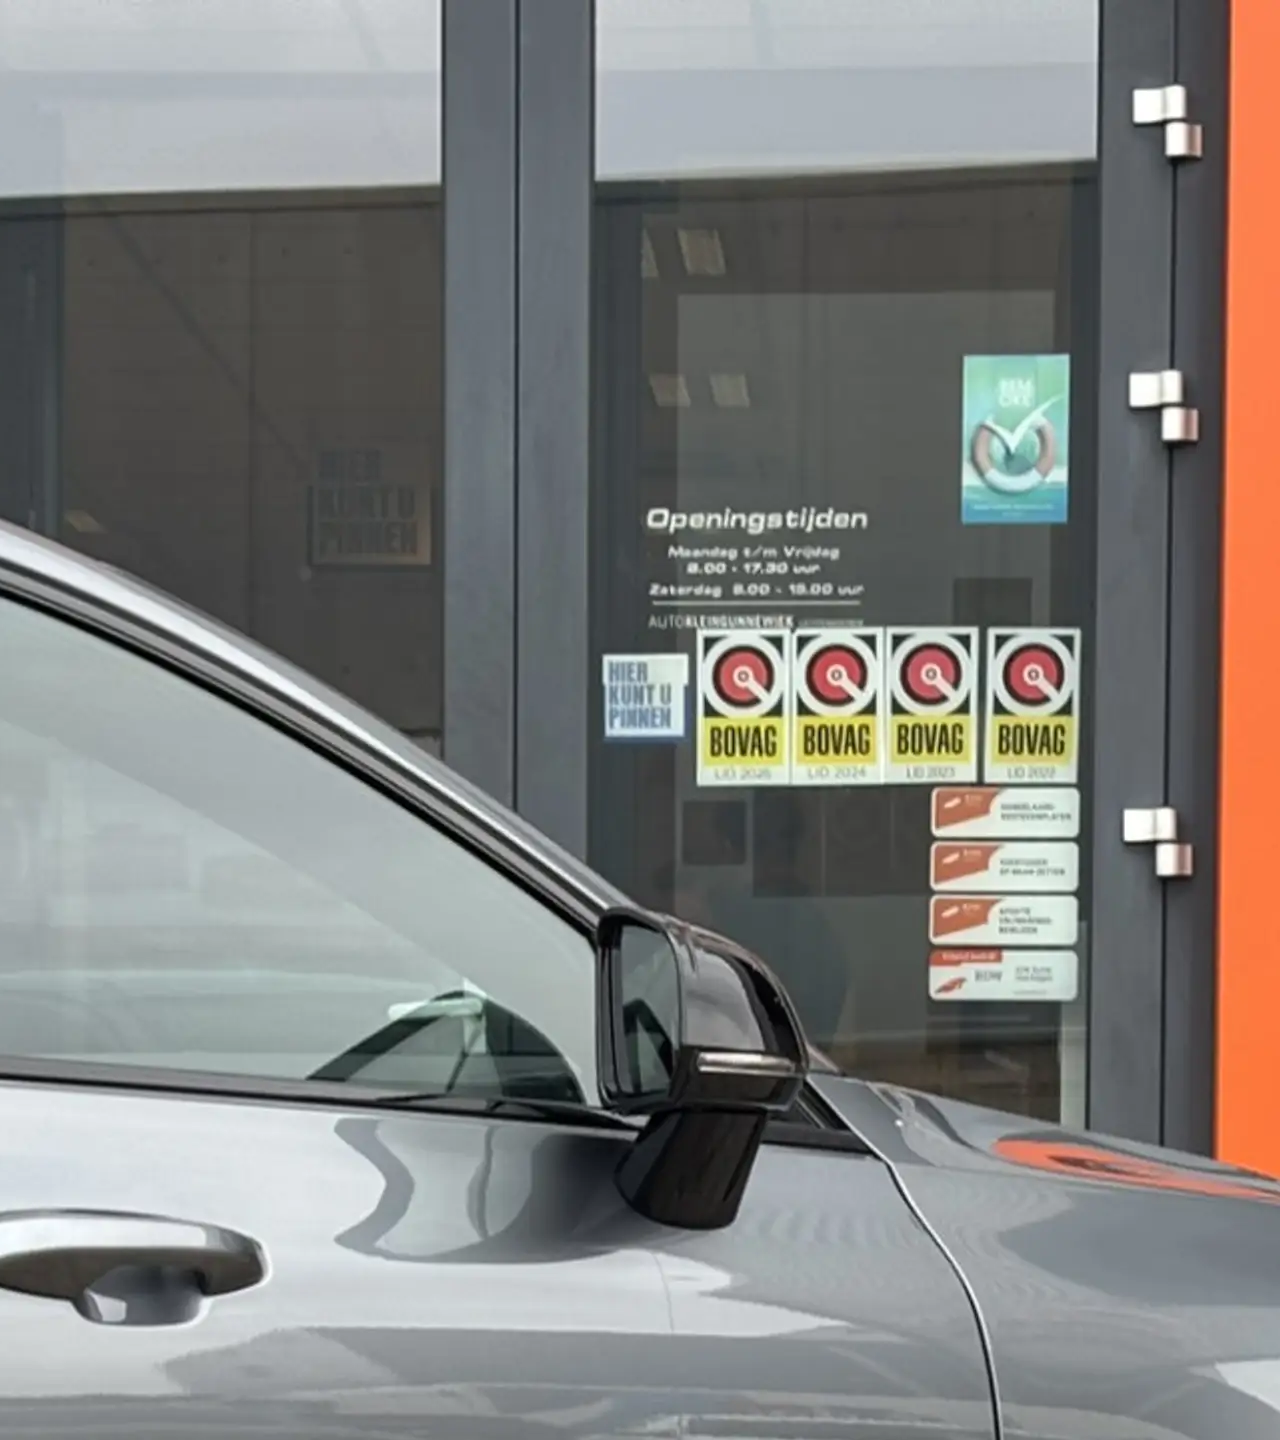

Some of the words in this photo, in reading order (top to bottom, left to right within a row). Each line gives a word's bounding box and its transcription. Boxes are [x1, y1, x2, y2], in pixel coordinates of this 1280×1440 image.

[646, 507, 869, 535] Openingstijden
[668, 546, 738, 560] Maandag
[743, 545, 777, 558] t/m
[783, 546, 840, 560] Vrijdag
[743, 562, 788, 575] 17.30
[793, 564, 821, 574] uur
[648, 582, 723, 598] Zaterdag
[837, 584, 865, 596] uur
[607, 660, 648, 682] HIER
[607, 683, 655, 705] KUNT
[660, 683, 672, 705] U
[608, 706, 672, 729] PINNEN
[710, 725, 777, 758] BOVAG
[803, 723, 870, 756] BOVAG
[897, 723, 964, 755] BOVAG
[998, 724, 1065, 756] BOVAG
[807, 766, 829, 779] LID
[835, 766, 866, 779] 2024
[906, 766, 925, 779] LID
[1007, 766, 1025, 779] LID
